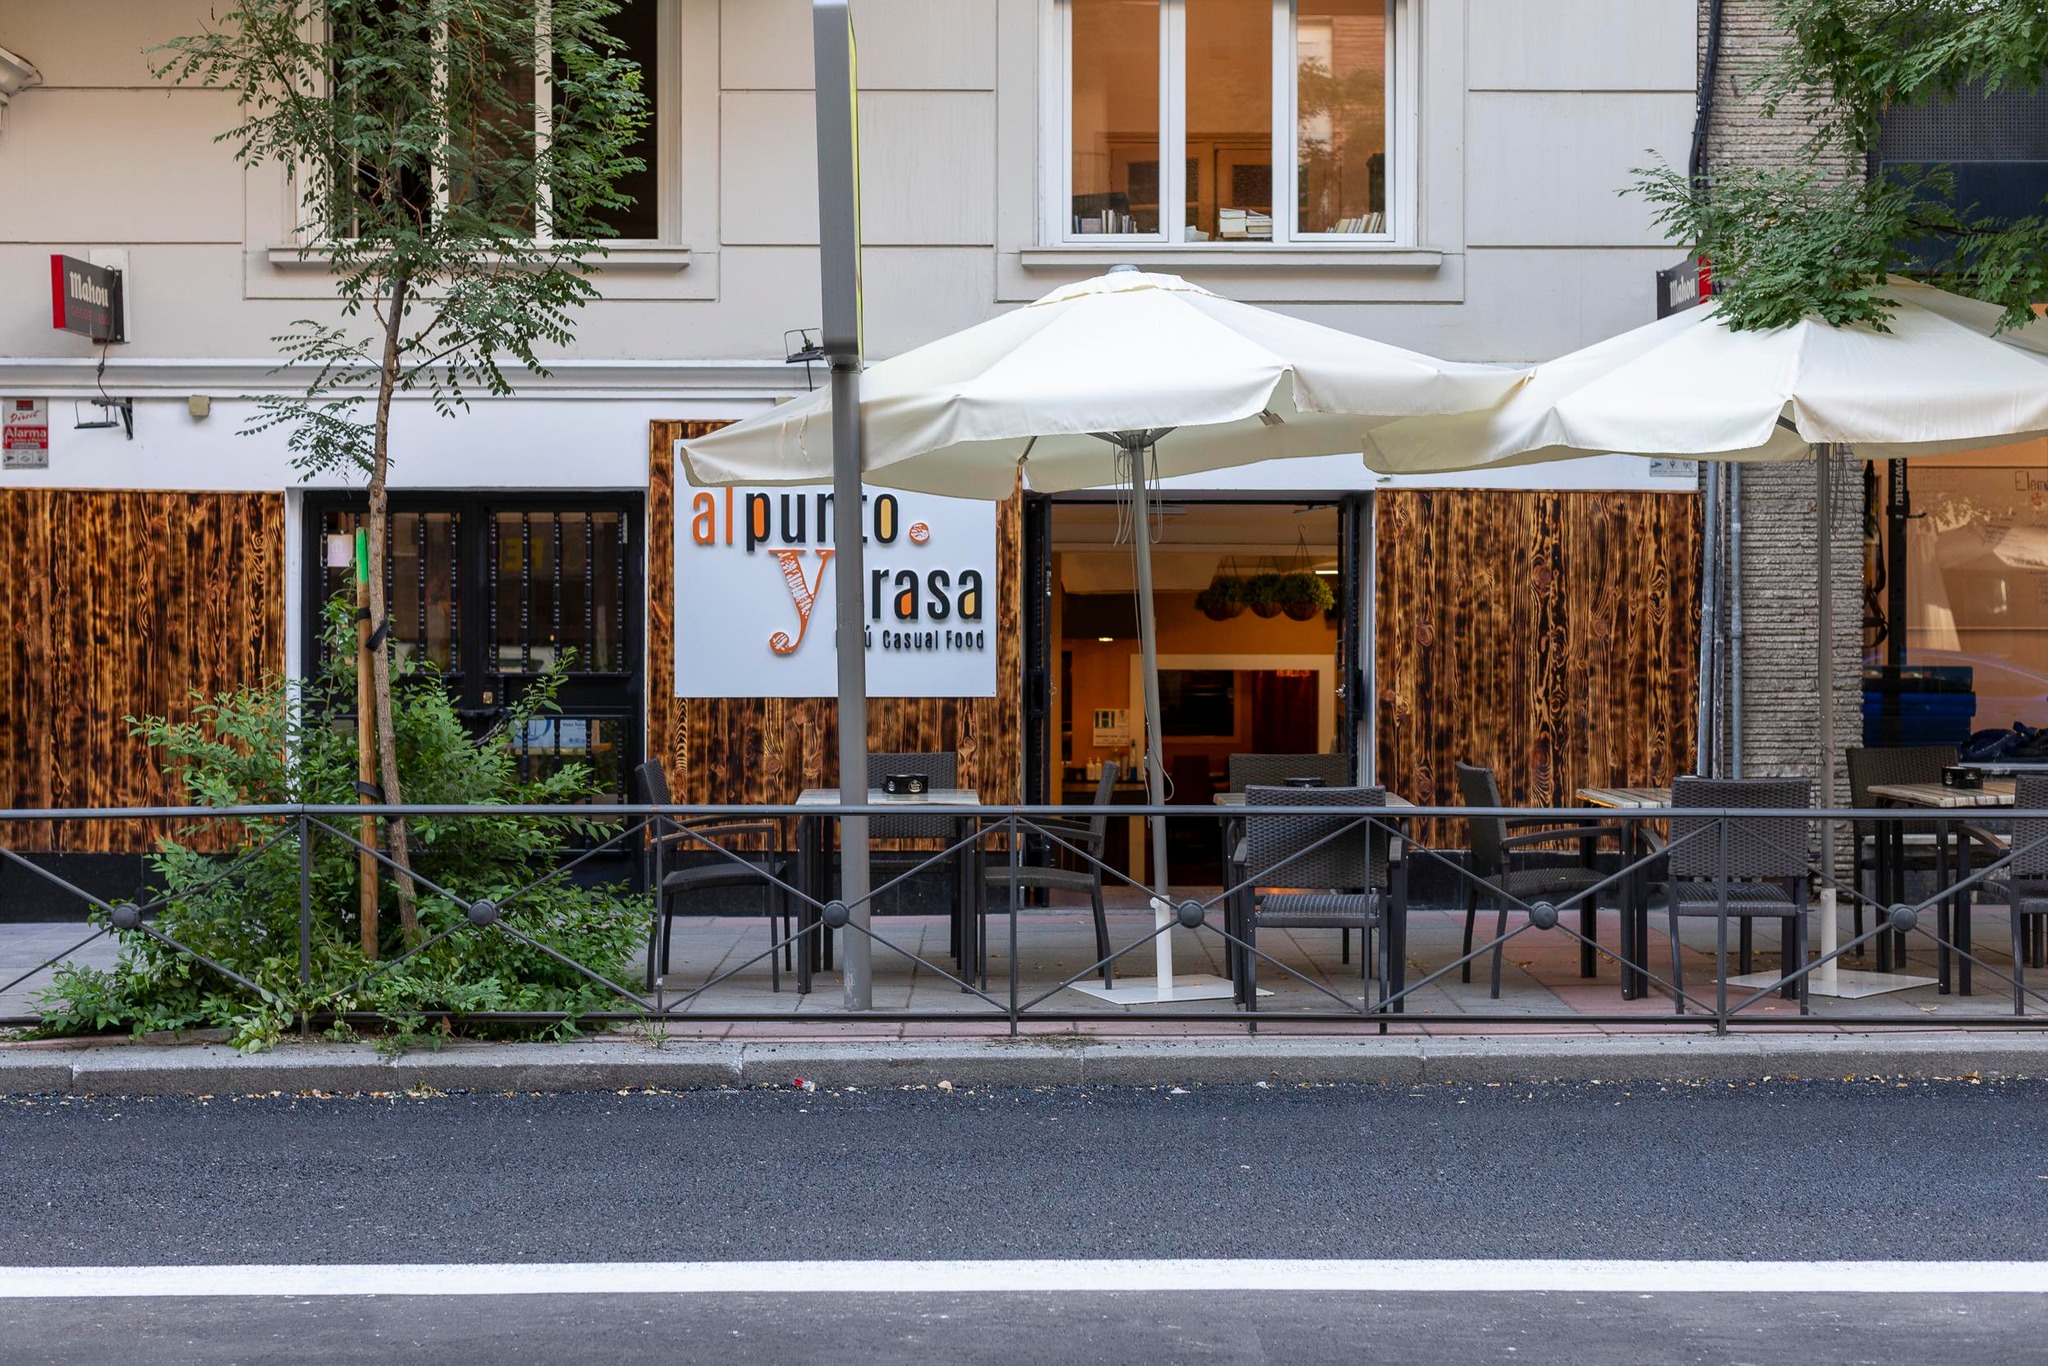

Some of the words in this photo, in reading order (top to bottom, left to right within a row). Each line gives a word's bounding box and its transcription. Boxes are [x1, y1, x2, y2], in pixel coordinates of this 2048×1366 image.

[69, 271, 109, 308] Mahou
[1670, 275, 1696, 308] Mahou
[5, 427, 47, 439] Alarma
[692, 486, 733, 545] al
[745, 492, 899, 553] puno
[767, 549, 837, 654] y
[871, 569, 983, 620] rasa
[882, 629, 939, 650] Casual
[946, 629, 984, 650] Food
